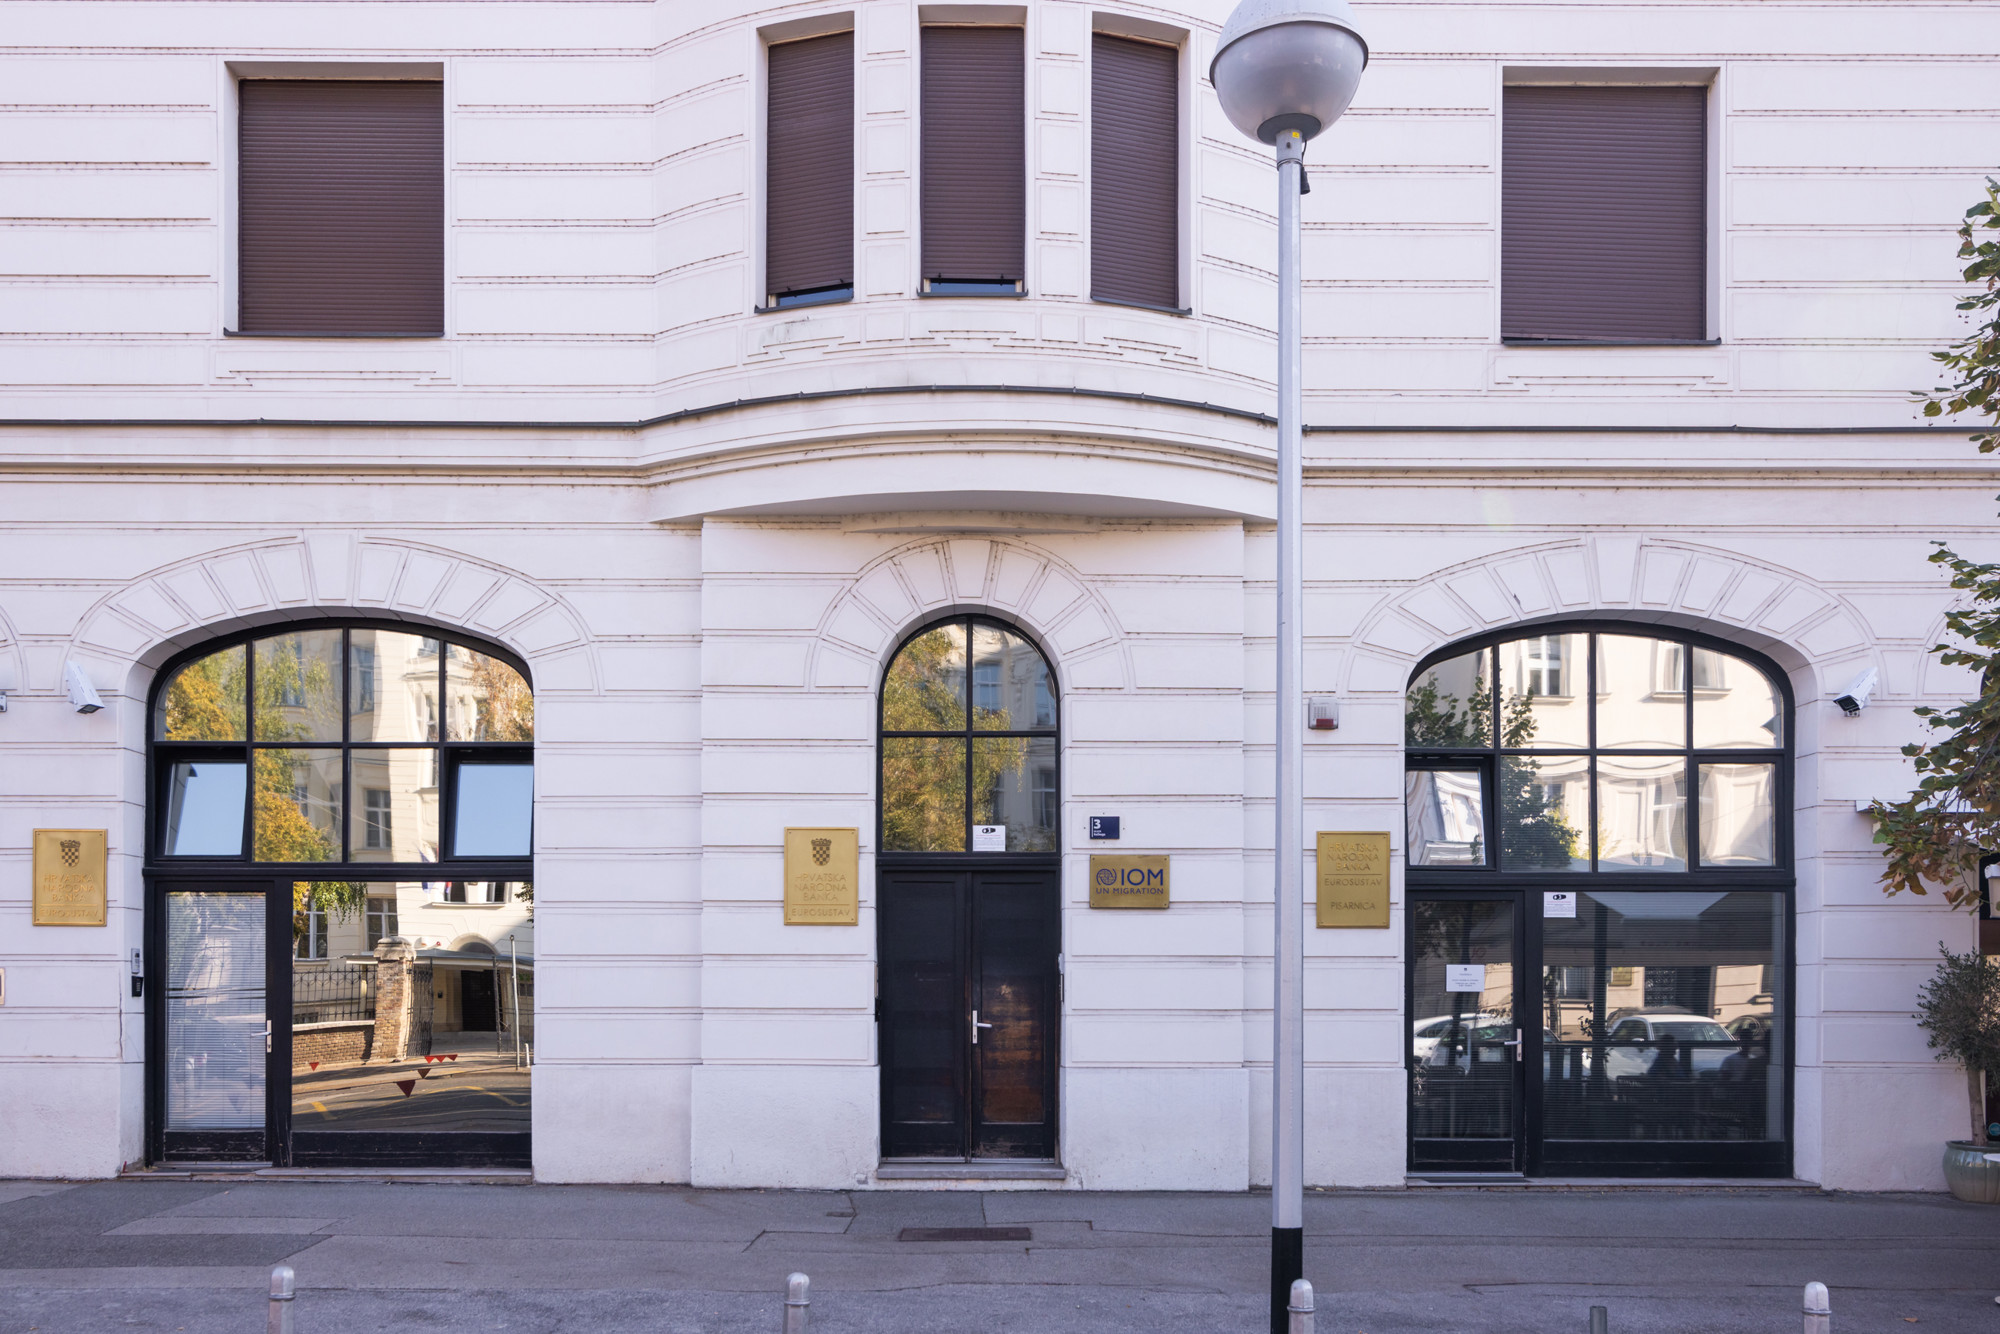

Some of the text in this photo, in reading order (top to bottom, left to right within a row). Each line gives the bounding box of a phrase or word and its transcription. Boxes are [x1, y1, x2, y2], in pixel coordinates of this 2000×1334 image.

[1093, 818, 1101, 829] 3
[1328, 842, 1379, 852] HRVATSKA
[1327, 852, 1379, 862] NARODNA
[1335, 862, 1371, 871] BANKA
[44, 874, 94, 883] HRVATSKA
[795, 872, 847, 882] HRVATSKA
[1121, 868, 1164, 886] IOM
[1324, 878, 1382, 886] EUROSUSTAV
[43, 883, 96, 893] NARODNA
[794, 882, 849, 892] NARODNA
[1095, 887, 1164, 895] UN MIGRATION
[52, 893, 87, 902] BANKA
[803, 892, 839, 901] BANKA
[1330, 901, 1376, 910] PISARNICA
[791, 908, 850, 917] EUROSUSTAV
